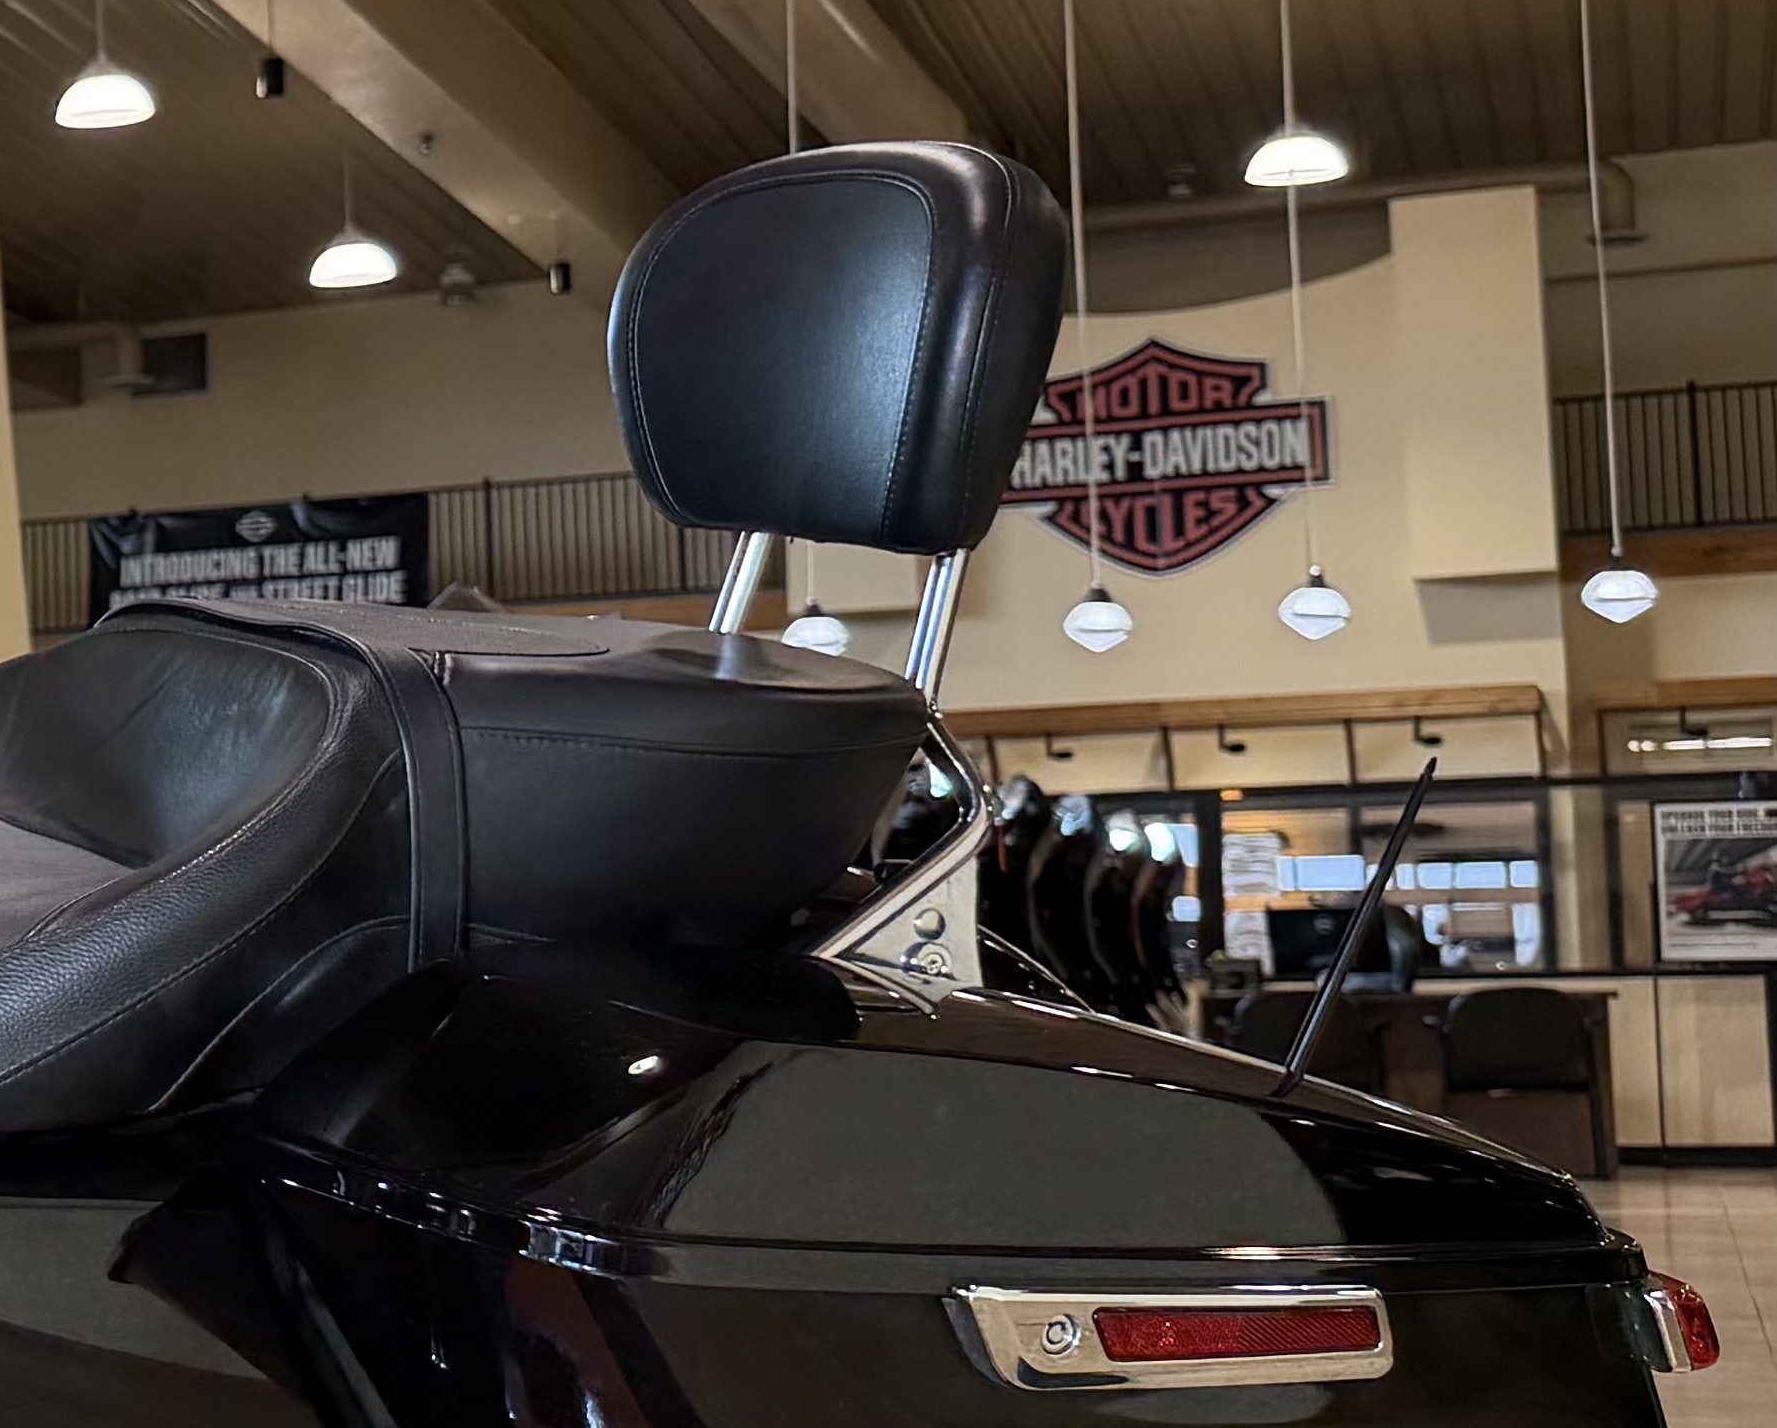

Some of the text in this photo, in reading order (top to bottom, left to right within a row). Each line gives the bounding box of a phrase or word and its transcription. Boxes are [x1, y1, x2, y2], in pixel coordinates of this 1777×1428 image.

[1077, 360, 1238, 420] MOTOR
[1012, 419, 1310, 489] HARLEY-DAVIDSON
[1080, 490, 1241, 555] CYCLES
[119, 534, 401, 589] INTRODUCING THE ALL-NEW
